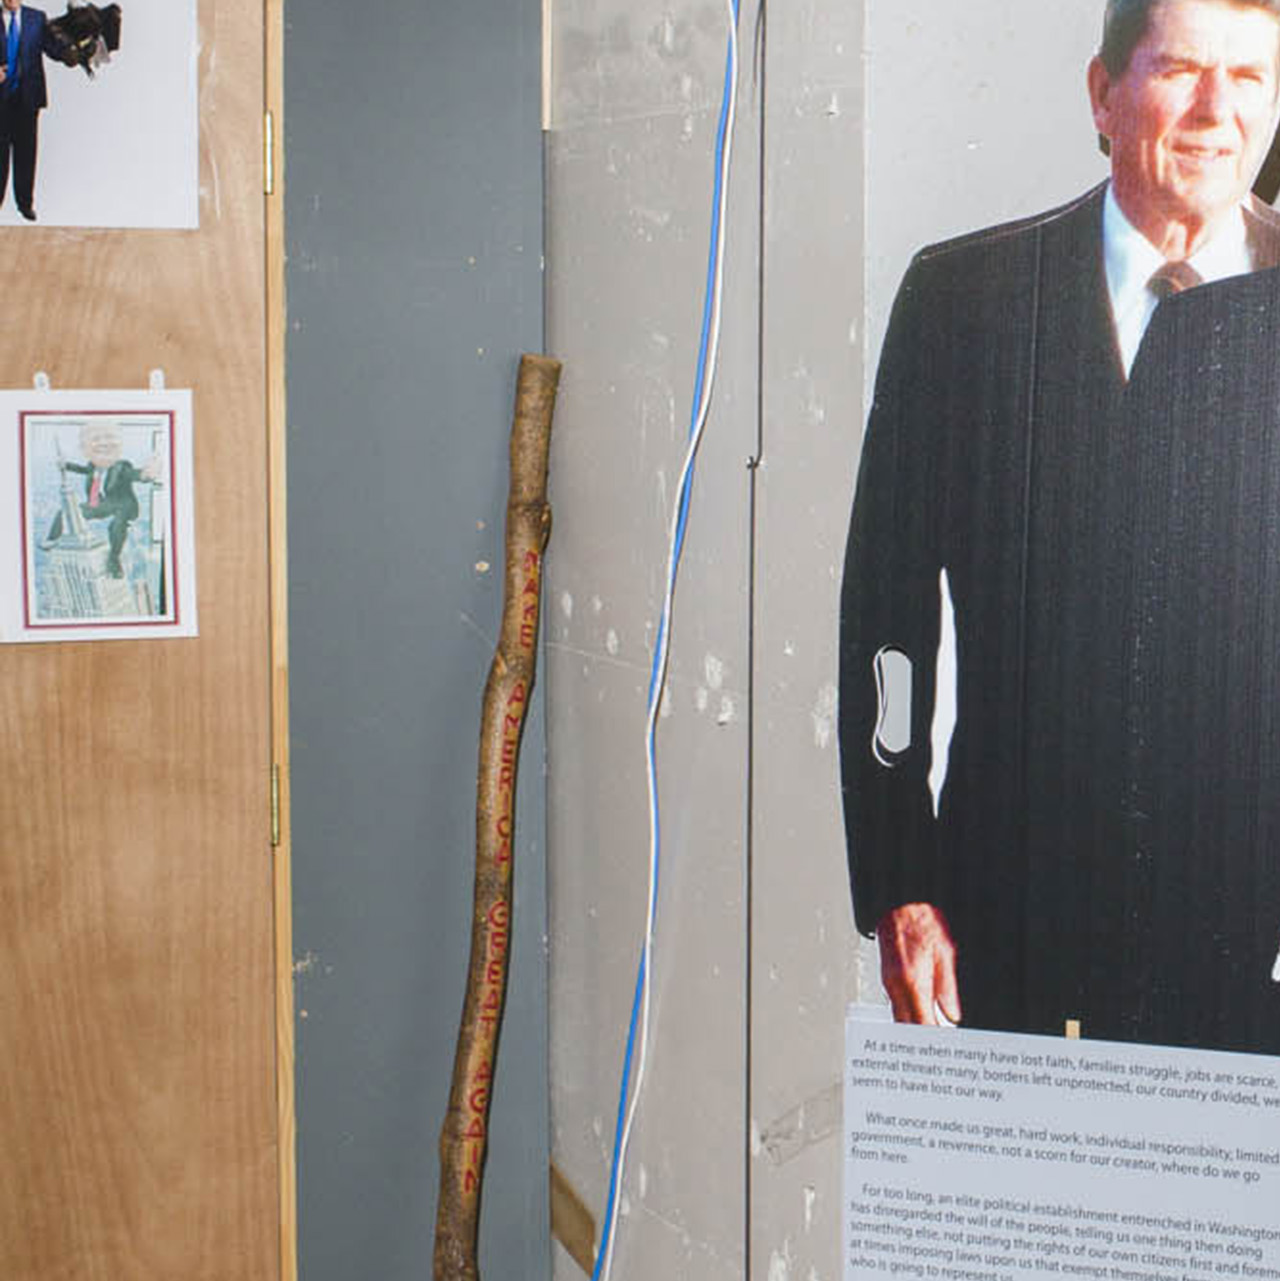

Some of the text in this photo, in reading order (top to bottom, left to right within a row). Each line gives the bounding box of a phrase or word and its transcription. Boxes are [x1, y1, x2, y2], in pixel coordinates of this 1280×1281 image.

[461, 549, 539, 1194] MAKE AMERICA GREAT AGAIN
[851, 1057, 899, 1071] external
[901, 1060, 942, 1075] threats
[982, 1067, 1028, 1084] borders
[1031, 1071, 1052, 1086] left
[1135, 1084, 1157, 1096] our
[1158, 1086, 1207, 1102] country
[863, 1038, 876, 1051] At
[888, 1041, 915, 1055] time
[918, 1043, 951, 1057] when
[953, 1049, 987, 1064] many
[989, 1048, 1018, 1065] have
[1020, 1053, 1043, 1067] lost
[1078, 1057, 1125, 1074] families
[1183, 1068, 1211, 1083] jobs
[1213, 1072, 1234, 1084] are
[852, 1075, 882, 1087] seem
[885, 1077, 898, 1090] to
[899, 1077, 928, 1092] have
[930, 1079, 952, 1095] lost
[955, 1085, 975, 1097] our
[850, 1144, 878, 1160] from
[865, 1110, 896, 1127] What
[897, 1117, 927, 1129] once
[929, 1120, 963, 1133] made
[966, 1123, 980, 1134] us
[1018, 1126, 1047, 1141] hard
[1085, 1133, 1145, 1151] individual
[1235, 1147, 1280, 1165] limited
[1001, 1146, 1022, 1157] not
[1033, 1148, 1067, 1162] scorn
[1069, 1149, 1087, 1163] for
[1088, 1154, 1110, 1166] our
[1160, 1158, 1199, 1176] where
[1201, 1163, 1219, 1177] do
[1222, 1168, 1240, 1179] we
[1242, 1170, 1260, 1184] go
[861, 1182, 881, 1196] For
[883, 1186, 903, 1199] too
[937, 1194, 953, 1204] an
[955, 1193, 981, 1208] elite
[982, 1197, 1030, 1213] political
[1031, 1204, 1118, 1223] establishment
[1120, 1214, 1191, 1231] entrenched
[1193, 1218, 1206, 1232] in
[849, 1220, 912, 1240] something
[943, 1231, 963, 1243] not
[966, 1233, 1011, 1250] putting
[1013, 1237, 1033, 1251] the
[1036, 1240, 1070, 1255] rights
[1072, 1244, 1086, 1256] of
[1087, 1247, 1109, 1258] our
[1110, 1250, 1138, 1262] own
[1141, 1253, 1186, 1268] citizens
[1189, 1255, 1212, 1271] first
[1214, 1262, 1239, 1274] and
[850, 1200, 870, 1214] has
[872, 1203, 942, 1222] disregarded
[944, 1210, 964, 1225] the
[966, 1214, 987, 1227] will
[989, 1216, 1003, 1227] of
[1005, 1218, 1024, 1230] the
[1074, 1226, 1113, 1244] telling
[1116, 1232, 1130, 1243] us
[1132, 1234, 1156, 1246] one
[1159, 1234, 1191, 1253] thing
[1194, 1239, 1223, 1253] then
[1225, 1242, 1263, 1261] doing
[849, 1254, 876, 1269] who
[877, 1258, 886, 1271] is
[889, 1261, 923, 1277] going
[926, 1264, 939, 1277] to
[898, 1242, 953, 1263] imposing
[984, 1254, 1016, 1267] upon
[1018, 1258, 1032, 1269] us
[1034, 1256, 1059, 1272] that
[1061, 1263, 1107, 1278] exempt
